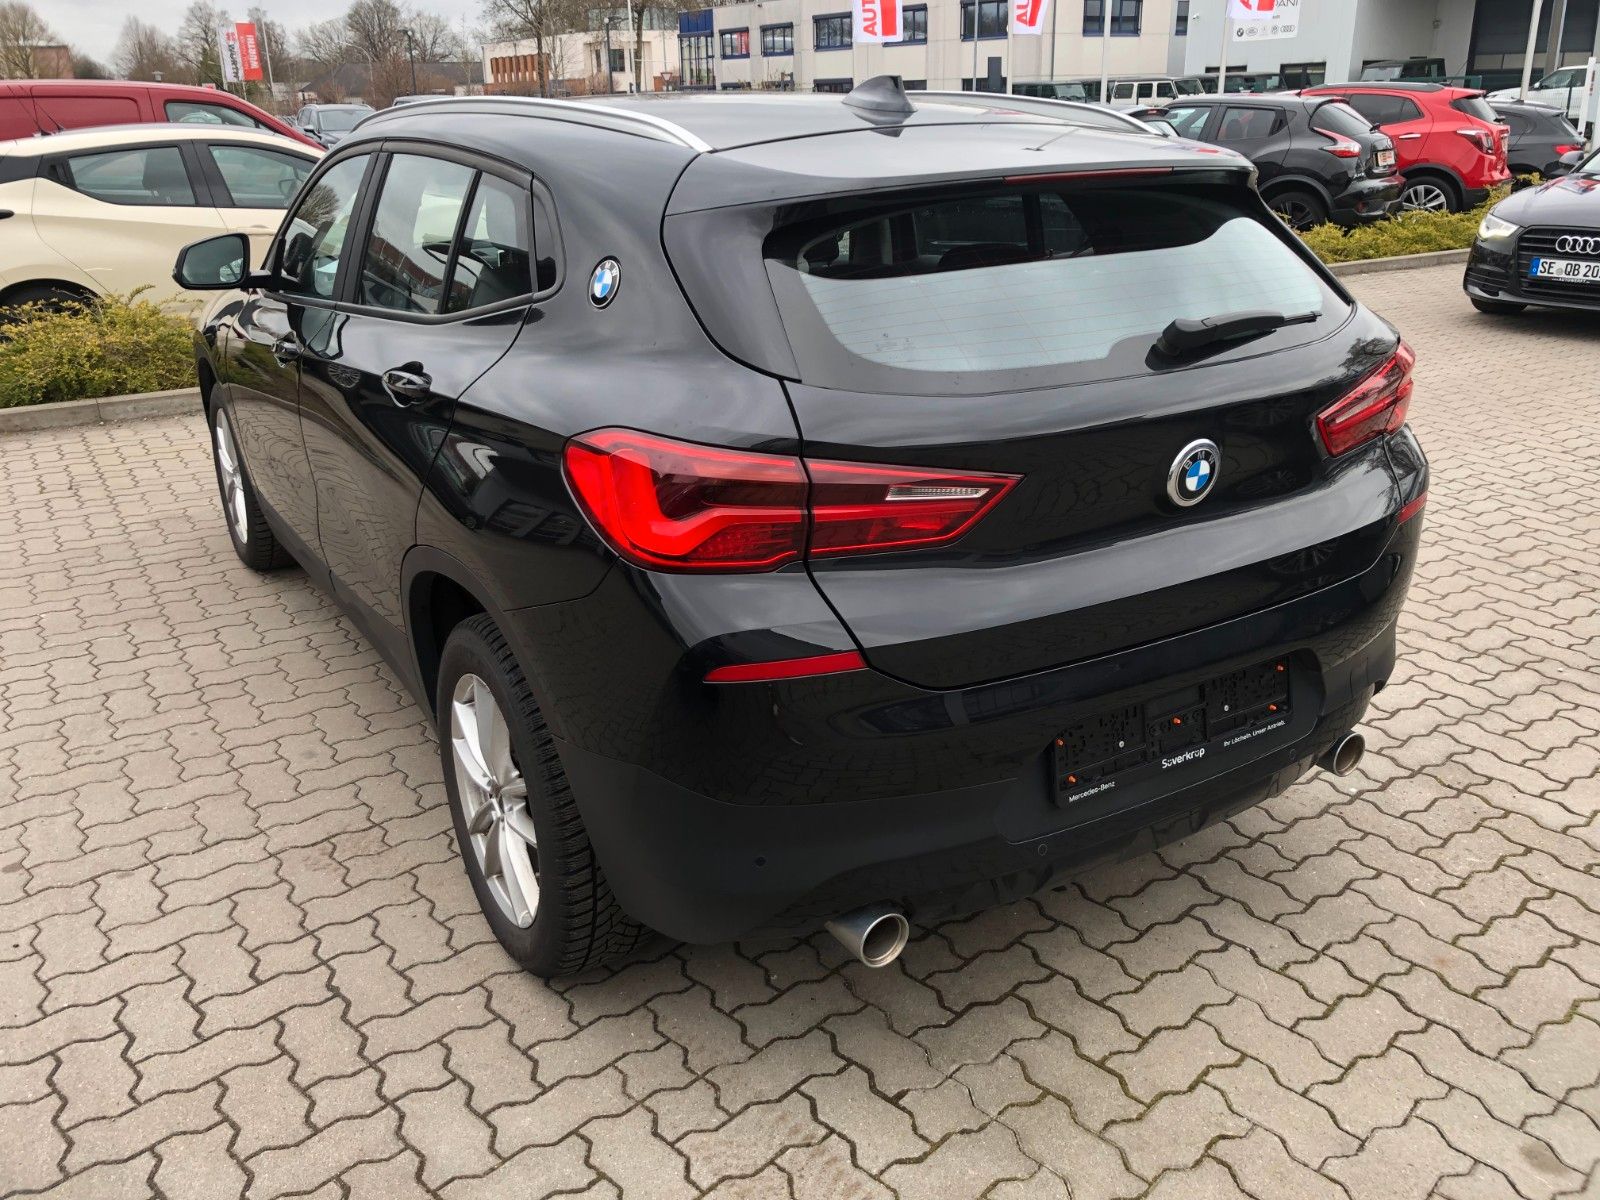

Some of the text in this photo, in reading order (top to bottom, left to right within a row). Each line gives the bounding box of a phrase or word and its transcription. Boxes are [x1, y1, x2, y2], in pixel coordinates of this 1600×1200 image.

[595, 261, 618, 277] BMW
[1540, 261, 1600, 279] SE QB 20
[1184, 451, 1215, 470] BMW
[1068, 781, 1116, 804] Mercedes-Benz
